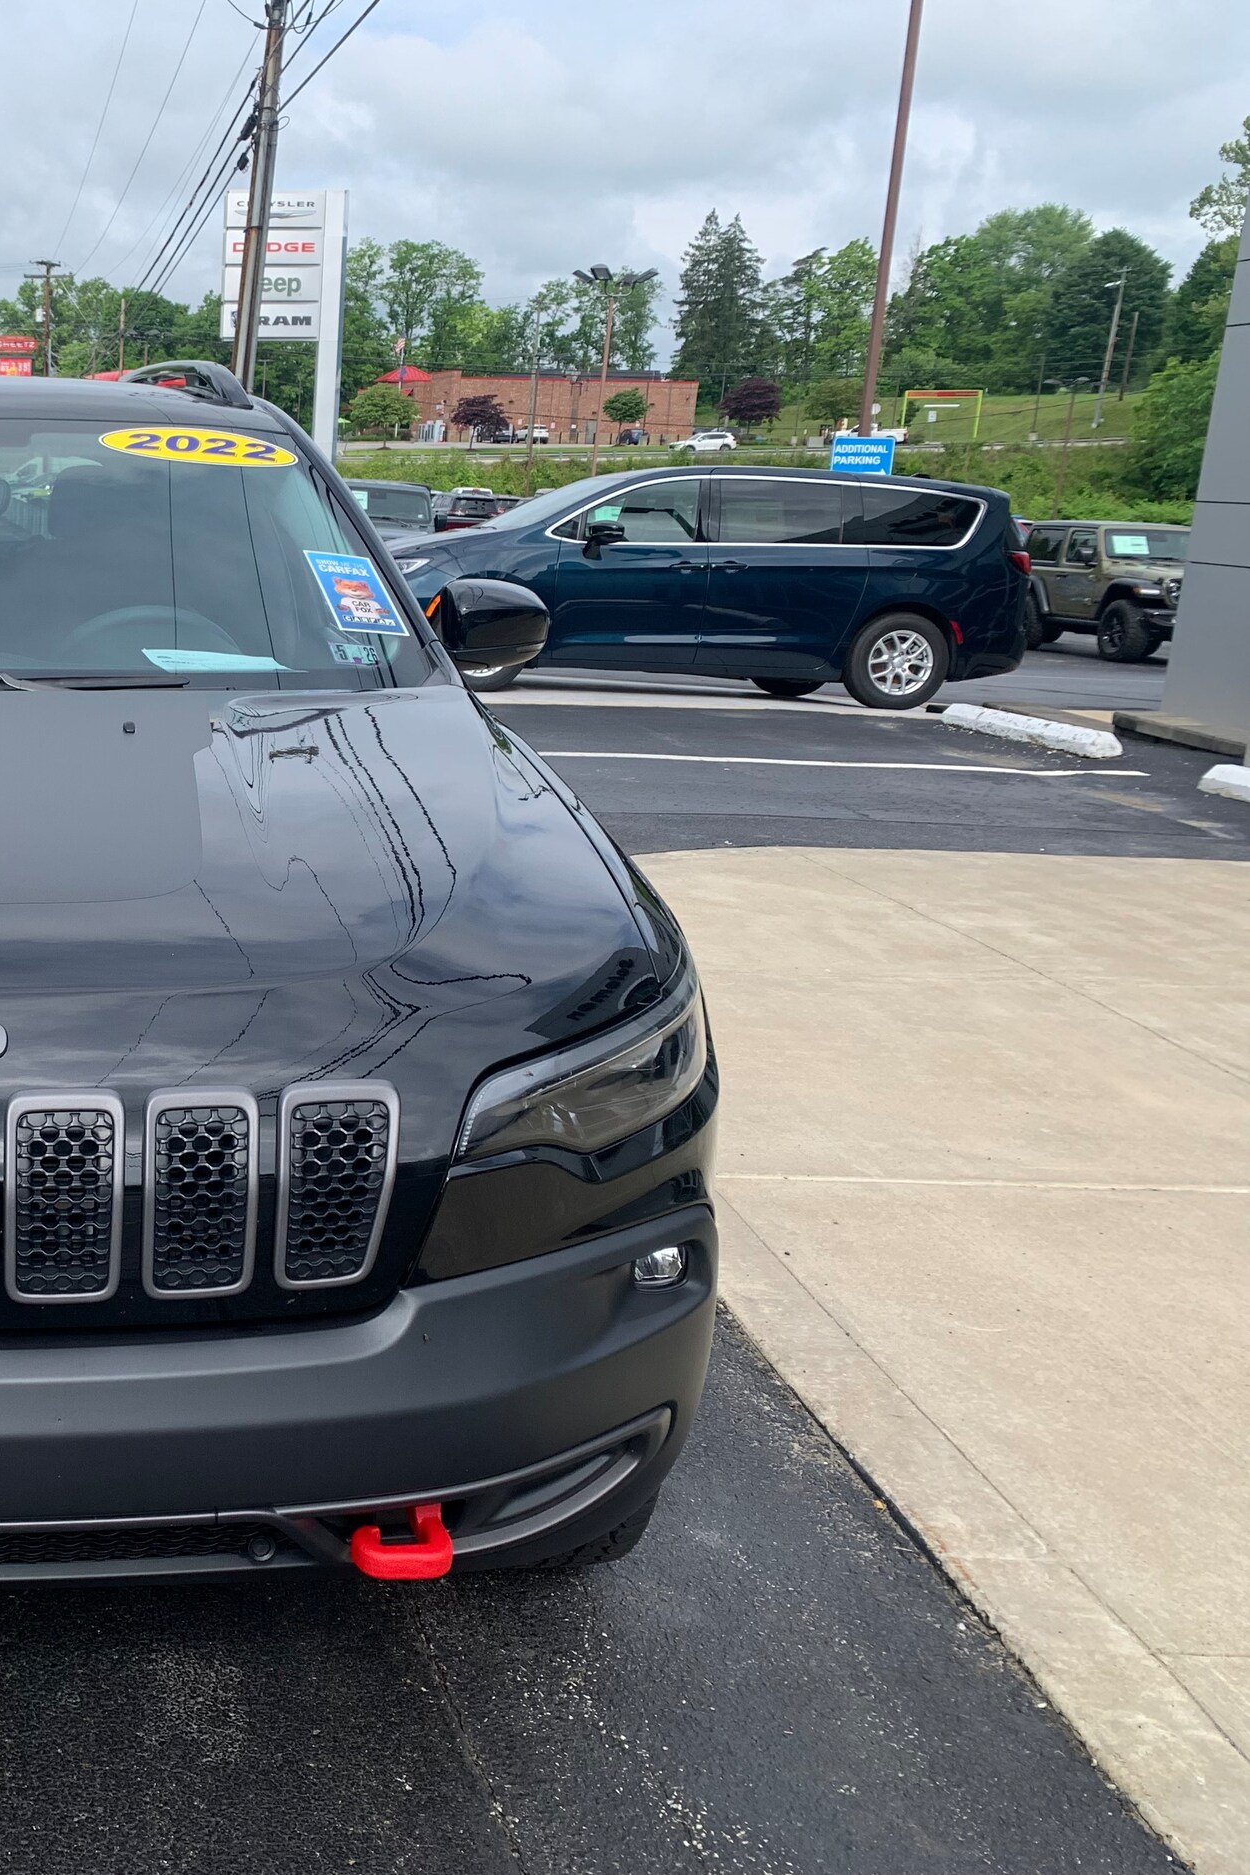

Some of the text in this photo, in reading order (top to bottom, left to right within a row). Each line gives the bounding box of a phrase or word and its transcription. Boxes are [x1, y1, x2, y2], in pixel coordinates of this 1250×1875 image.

[232, 242, 315, 252] DDGE
[260, 276, 302, 297] eep
[258, 315, 312, 326] RAM
[125, 432, 279, 463] 2022
[835, 444, 889, 454] ADDITIONAL
[834, 455, 881, 465] PARKING
[318, 564, 370, 577] CARFAX
[355, 606, 373, 614] FOX
[343, 615, 396, 626] CARFAX
